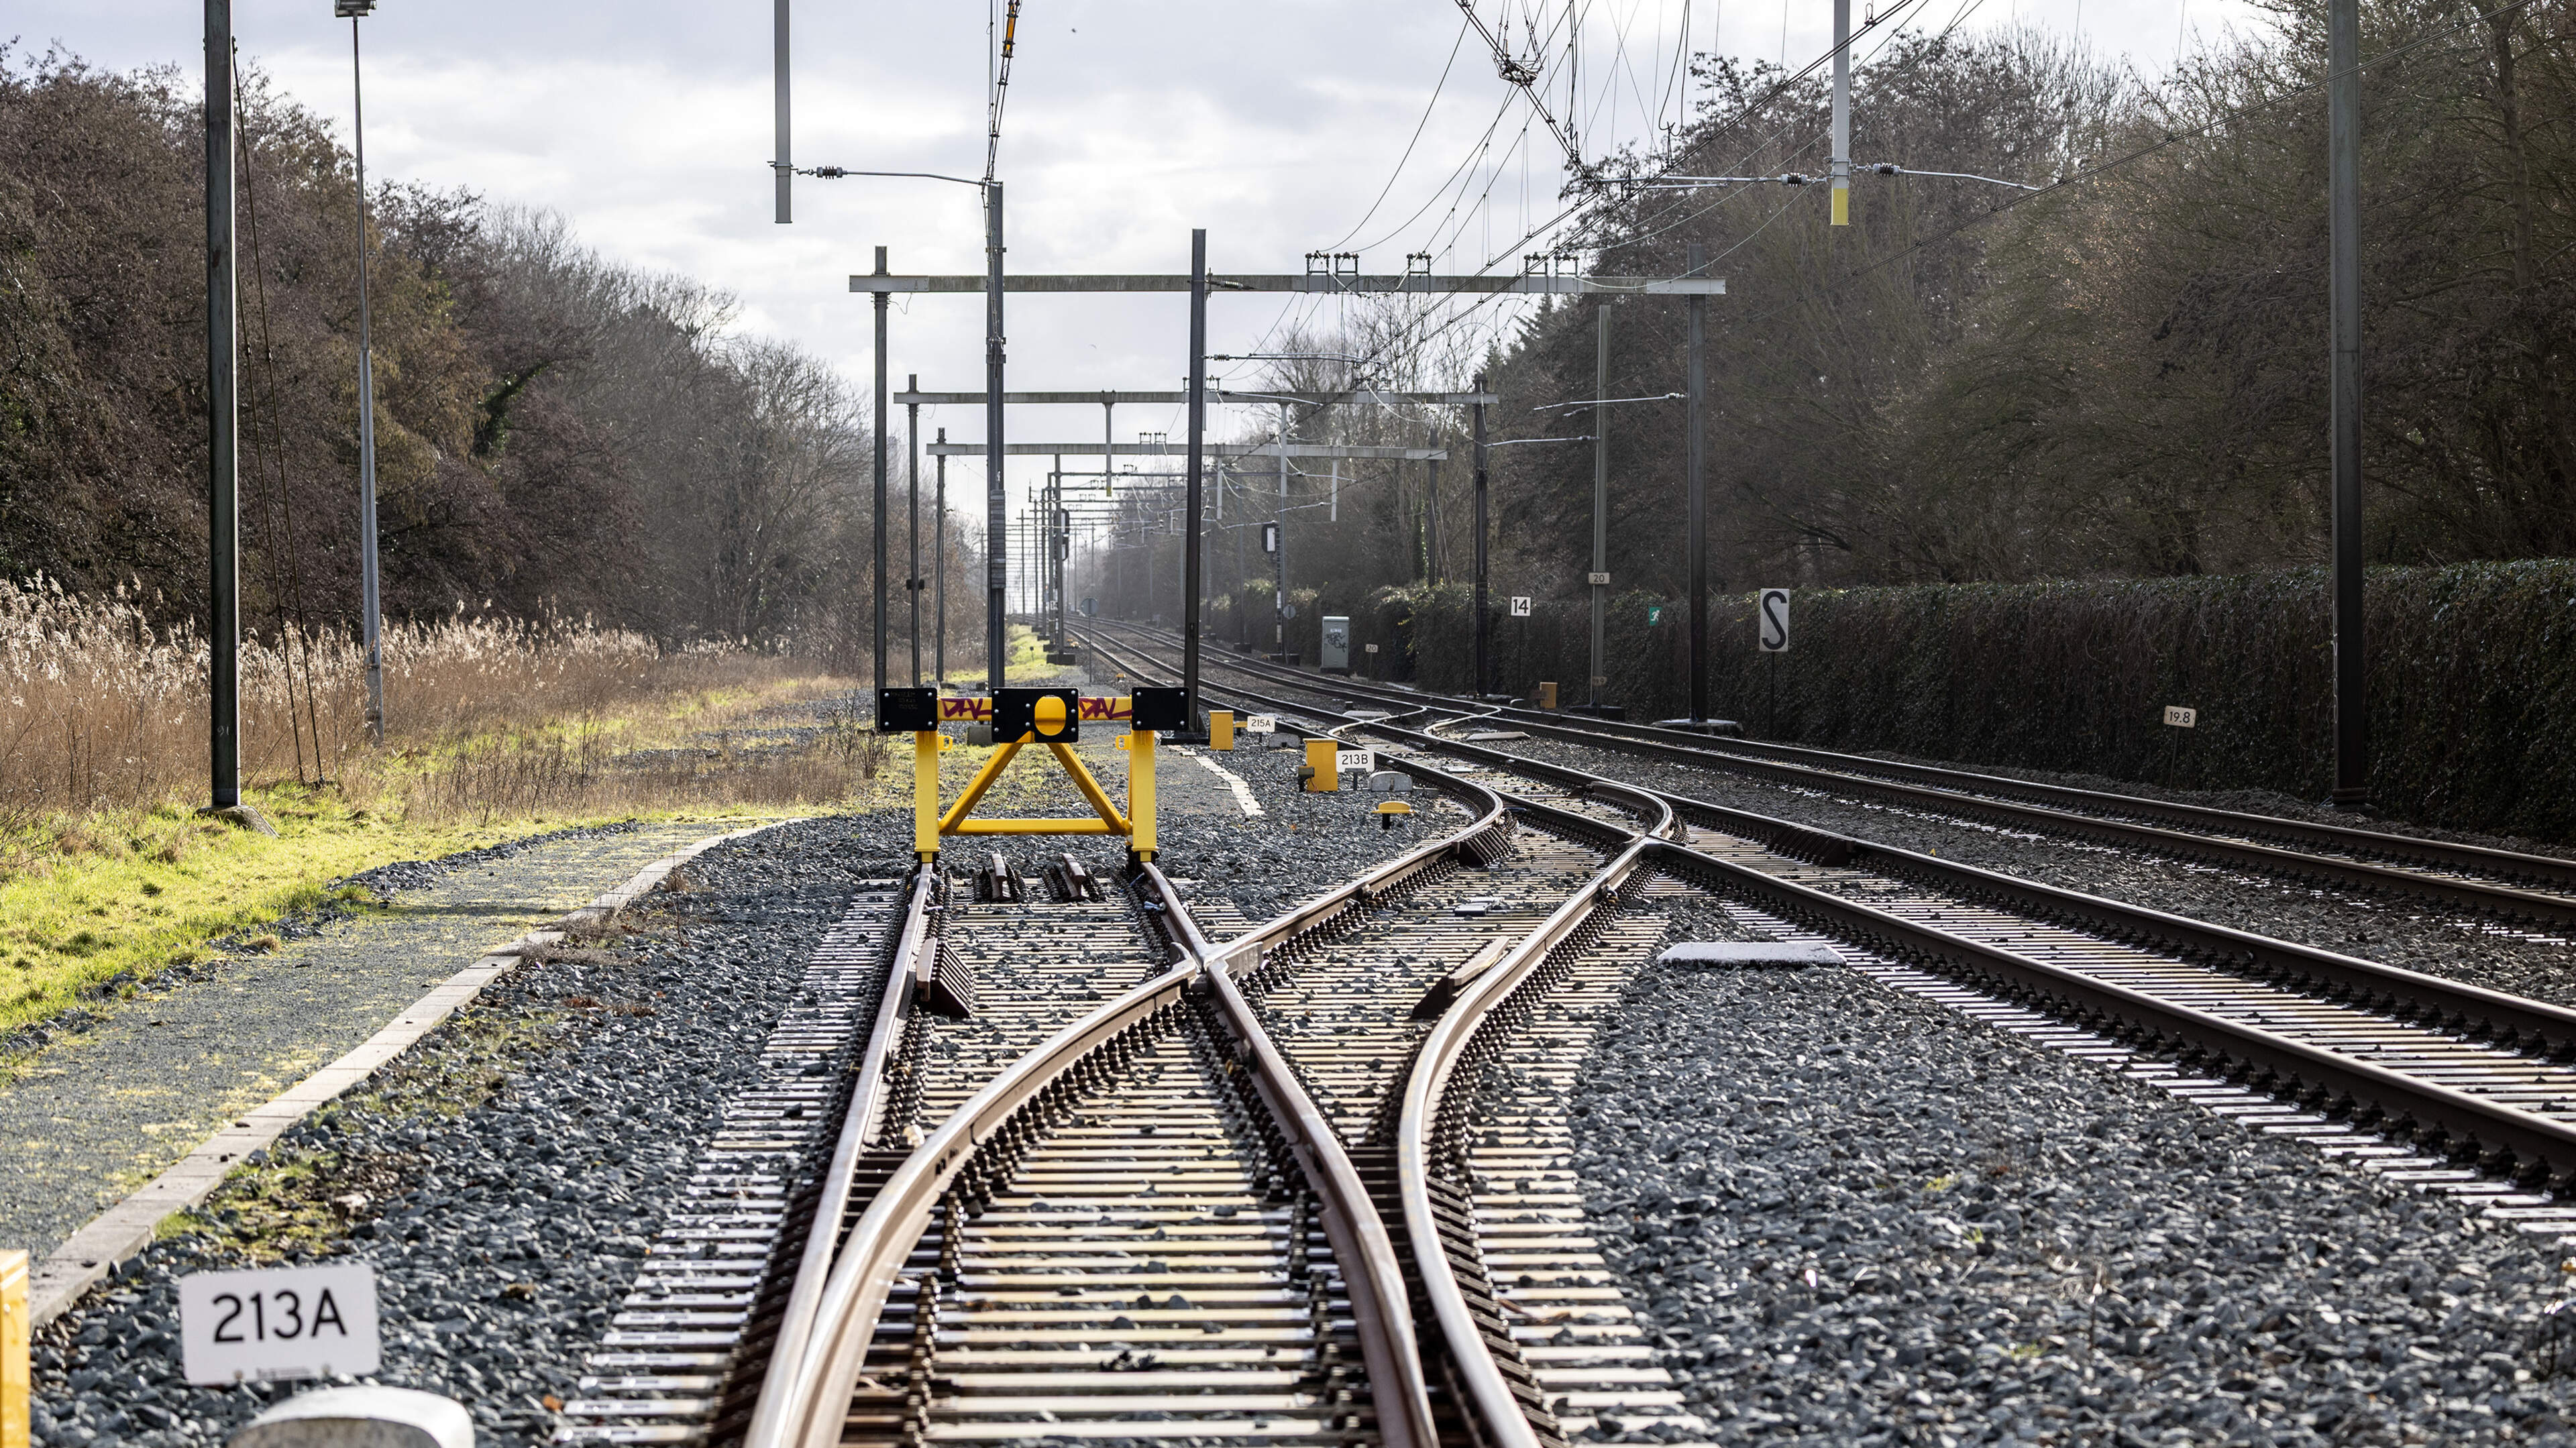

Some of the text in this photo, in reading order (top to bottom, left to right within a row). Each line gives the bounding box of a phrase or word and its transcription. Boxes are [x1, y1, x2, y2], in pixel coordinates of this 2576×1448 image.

[1593, 574, 1605, 583] 20
[1513, 599, 1529, 614] 14
[1762, 590, 1787, 650] S
[1251, 718, 1271, 728] 215A
[2169, 711, 2191, 724] 19.8
[1342, 754, 1368, 765] 213B
[212, 1286, 348, 1344] 213A
